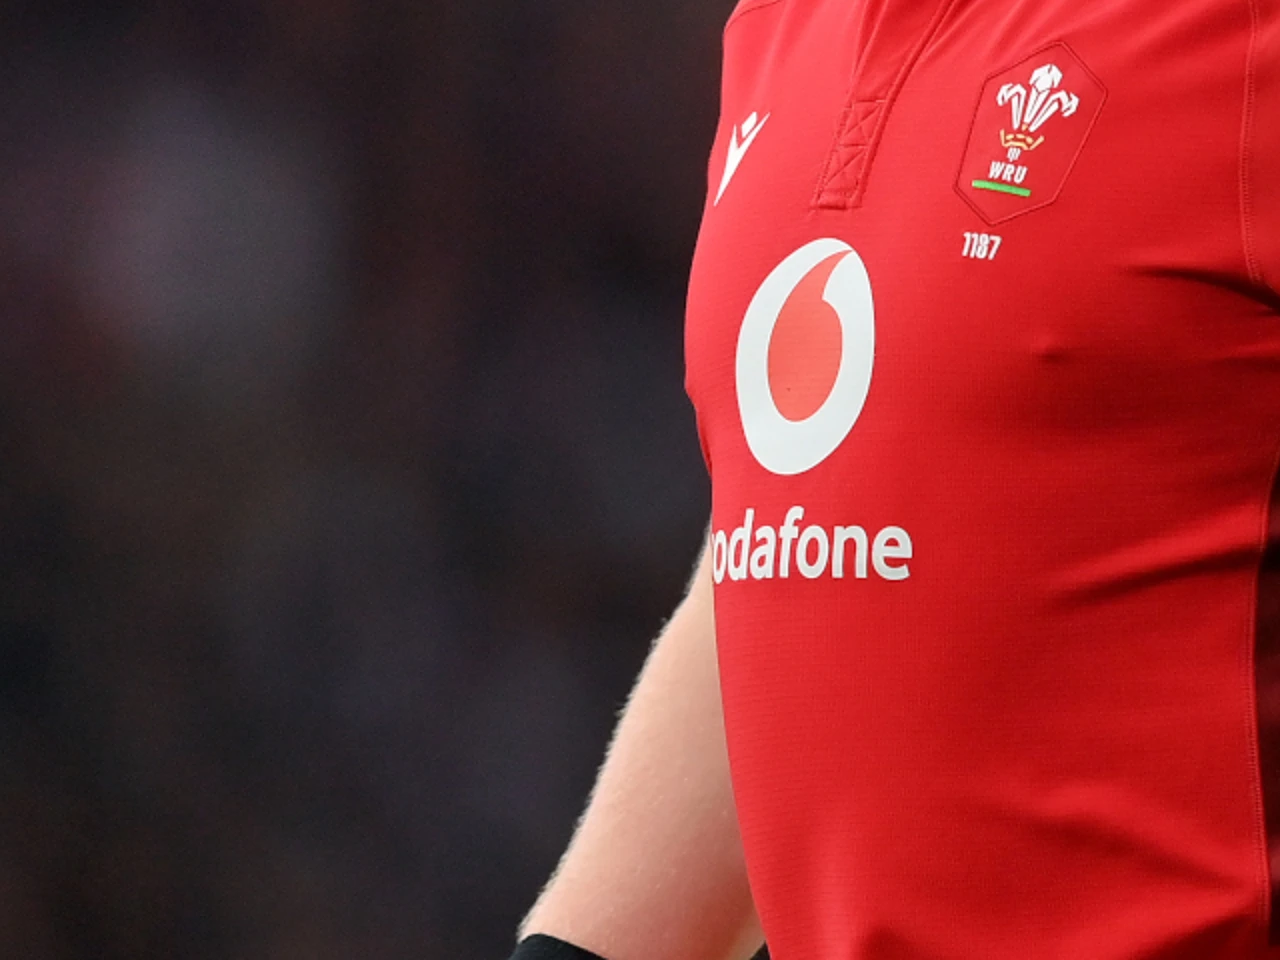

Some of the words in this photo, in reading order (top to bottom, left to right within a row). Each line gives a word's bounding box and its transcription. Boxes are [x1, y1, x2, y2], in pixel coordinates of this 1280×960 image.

[988, 160, 1028, 184] WRU
[962, 231, 1002, 260] 1187
[712, 505, 913, 584] odafone
